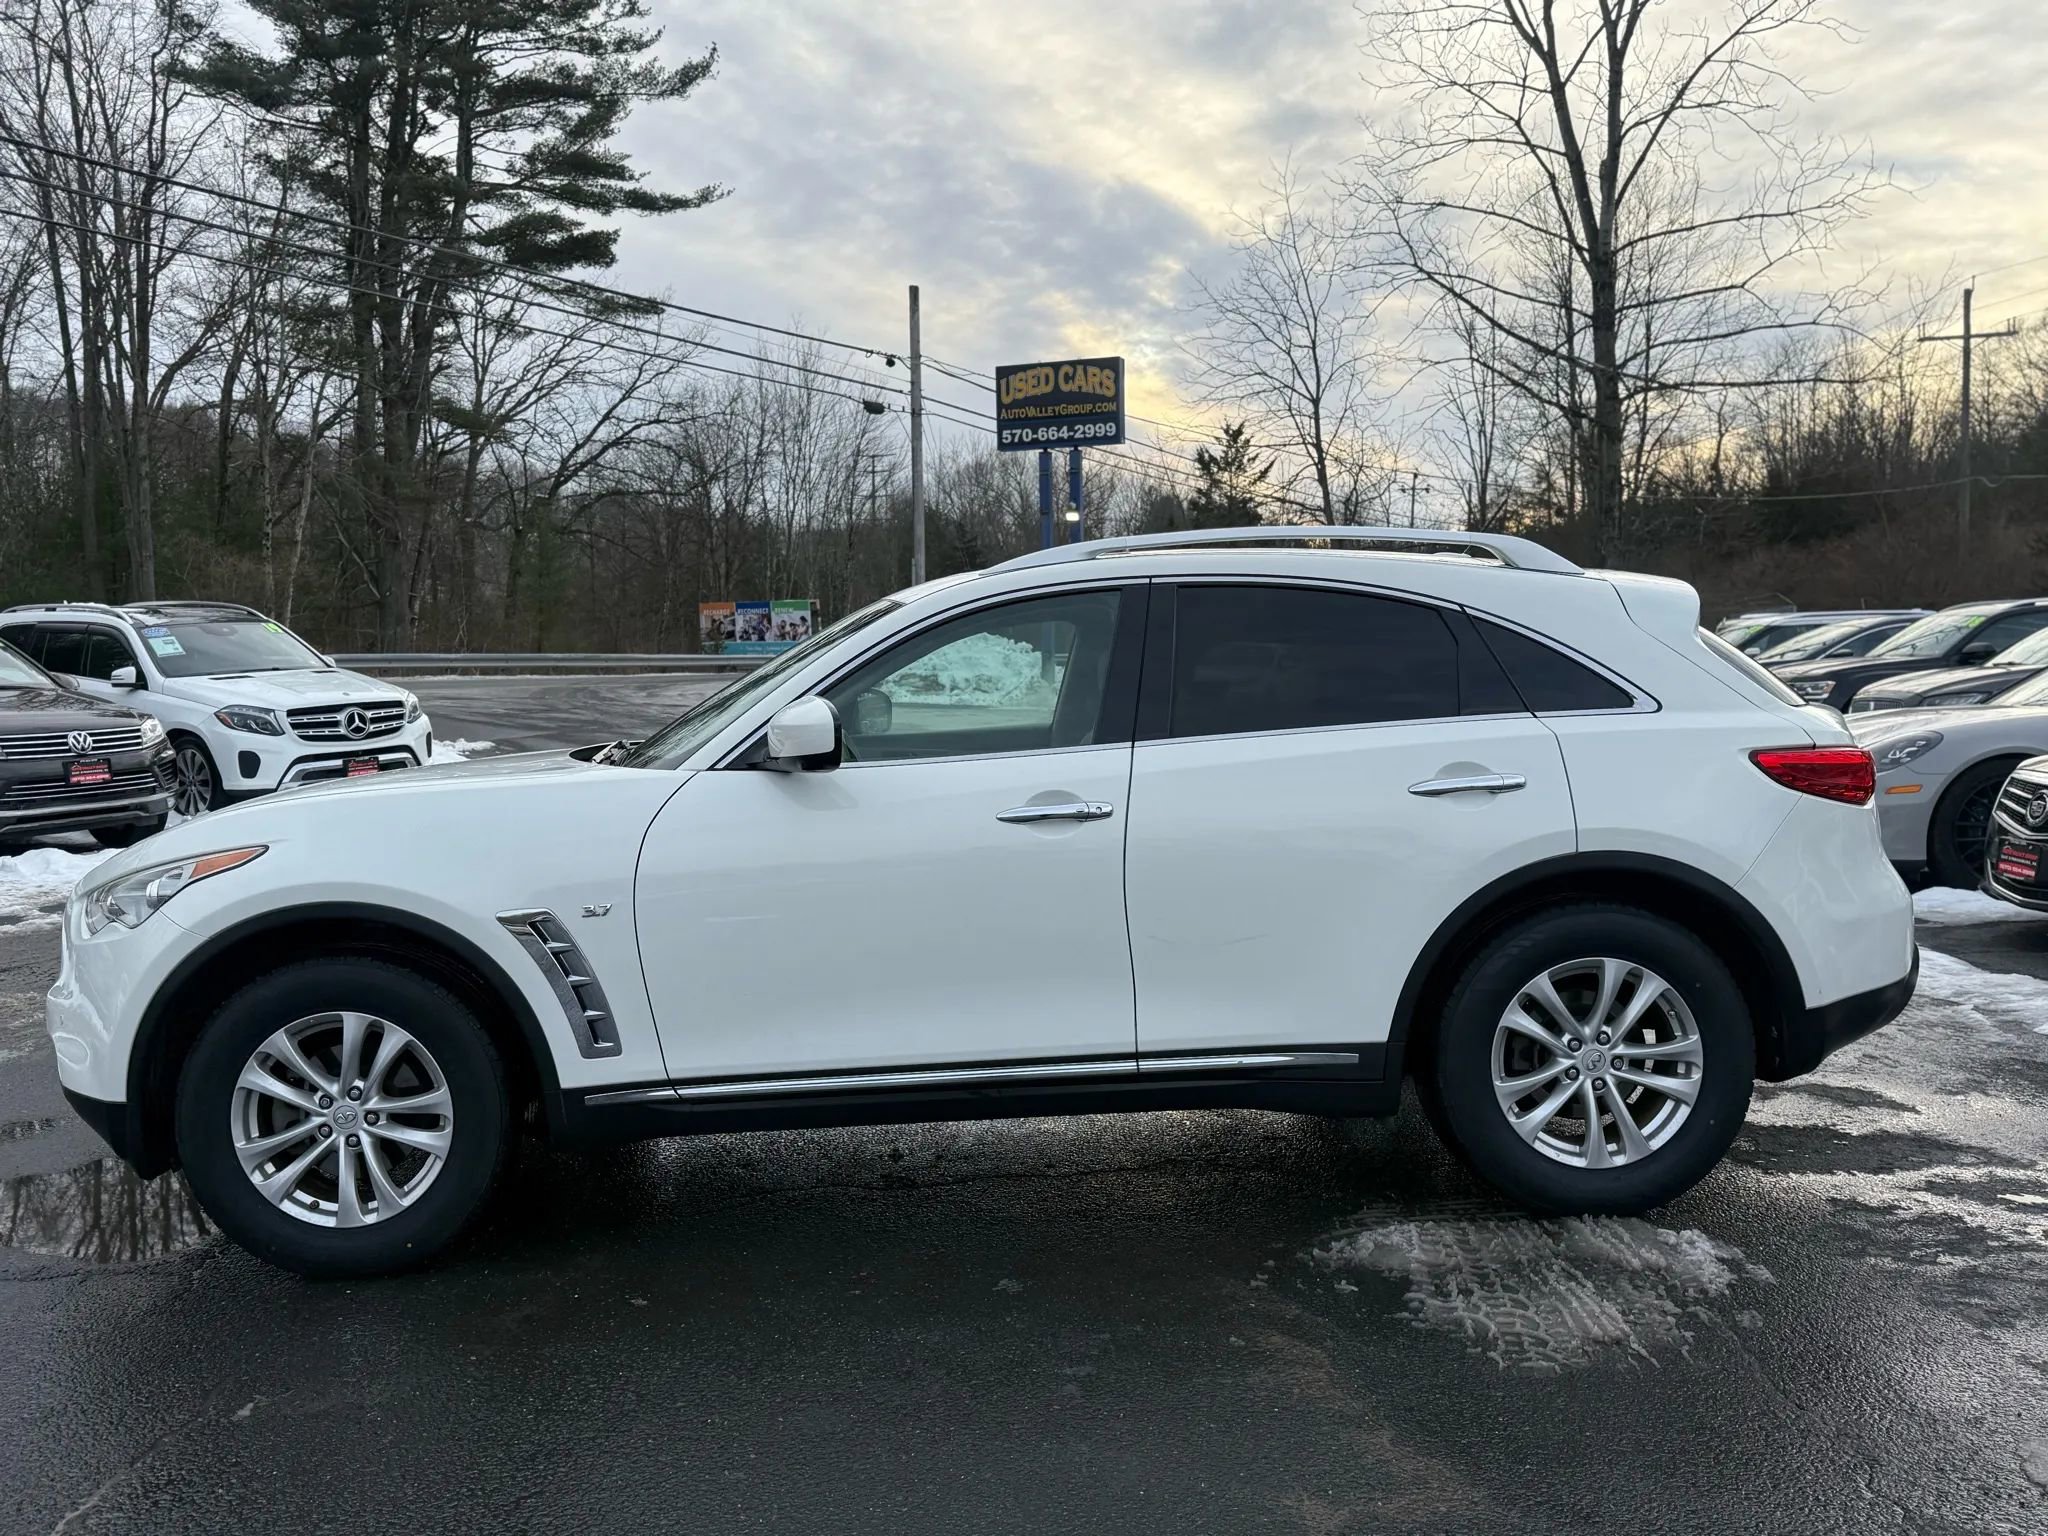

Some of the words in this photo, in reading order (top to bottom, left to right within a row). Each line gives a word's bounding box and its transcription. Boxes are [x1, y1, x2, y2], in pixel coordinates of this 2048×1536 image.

[1000, 366, 1055, 404] USED
[1058, 364, 1116, 398] CARS
[1002, 422, 1116, 443] 570-664-2999
[703, 608, 730, 616] RECHARGE
[737, 607, 769, 615] RECONNECT
